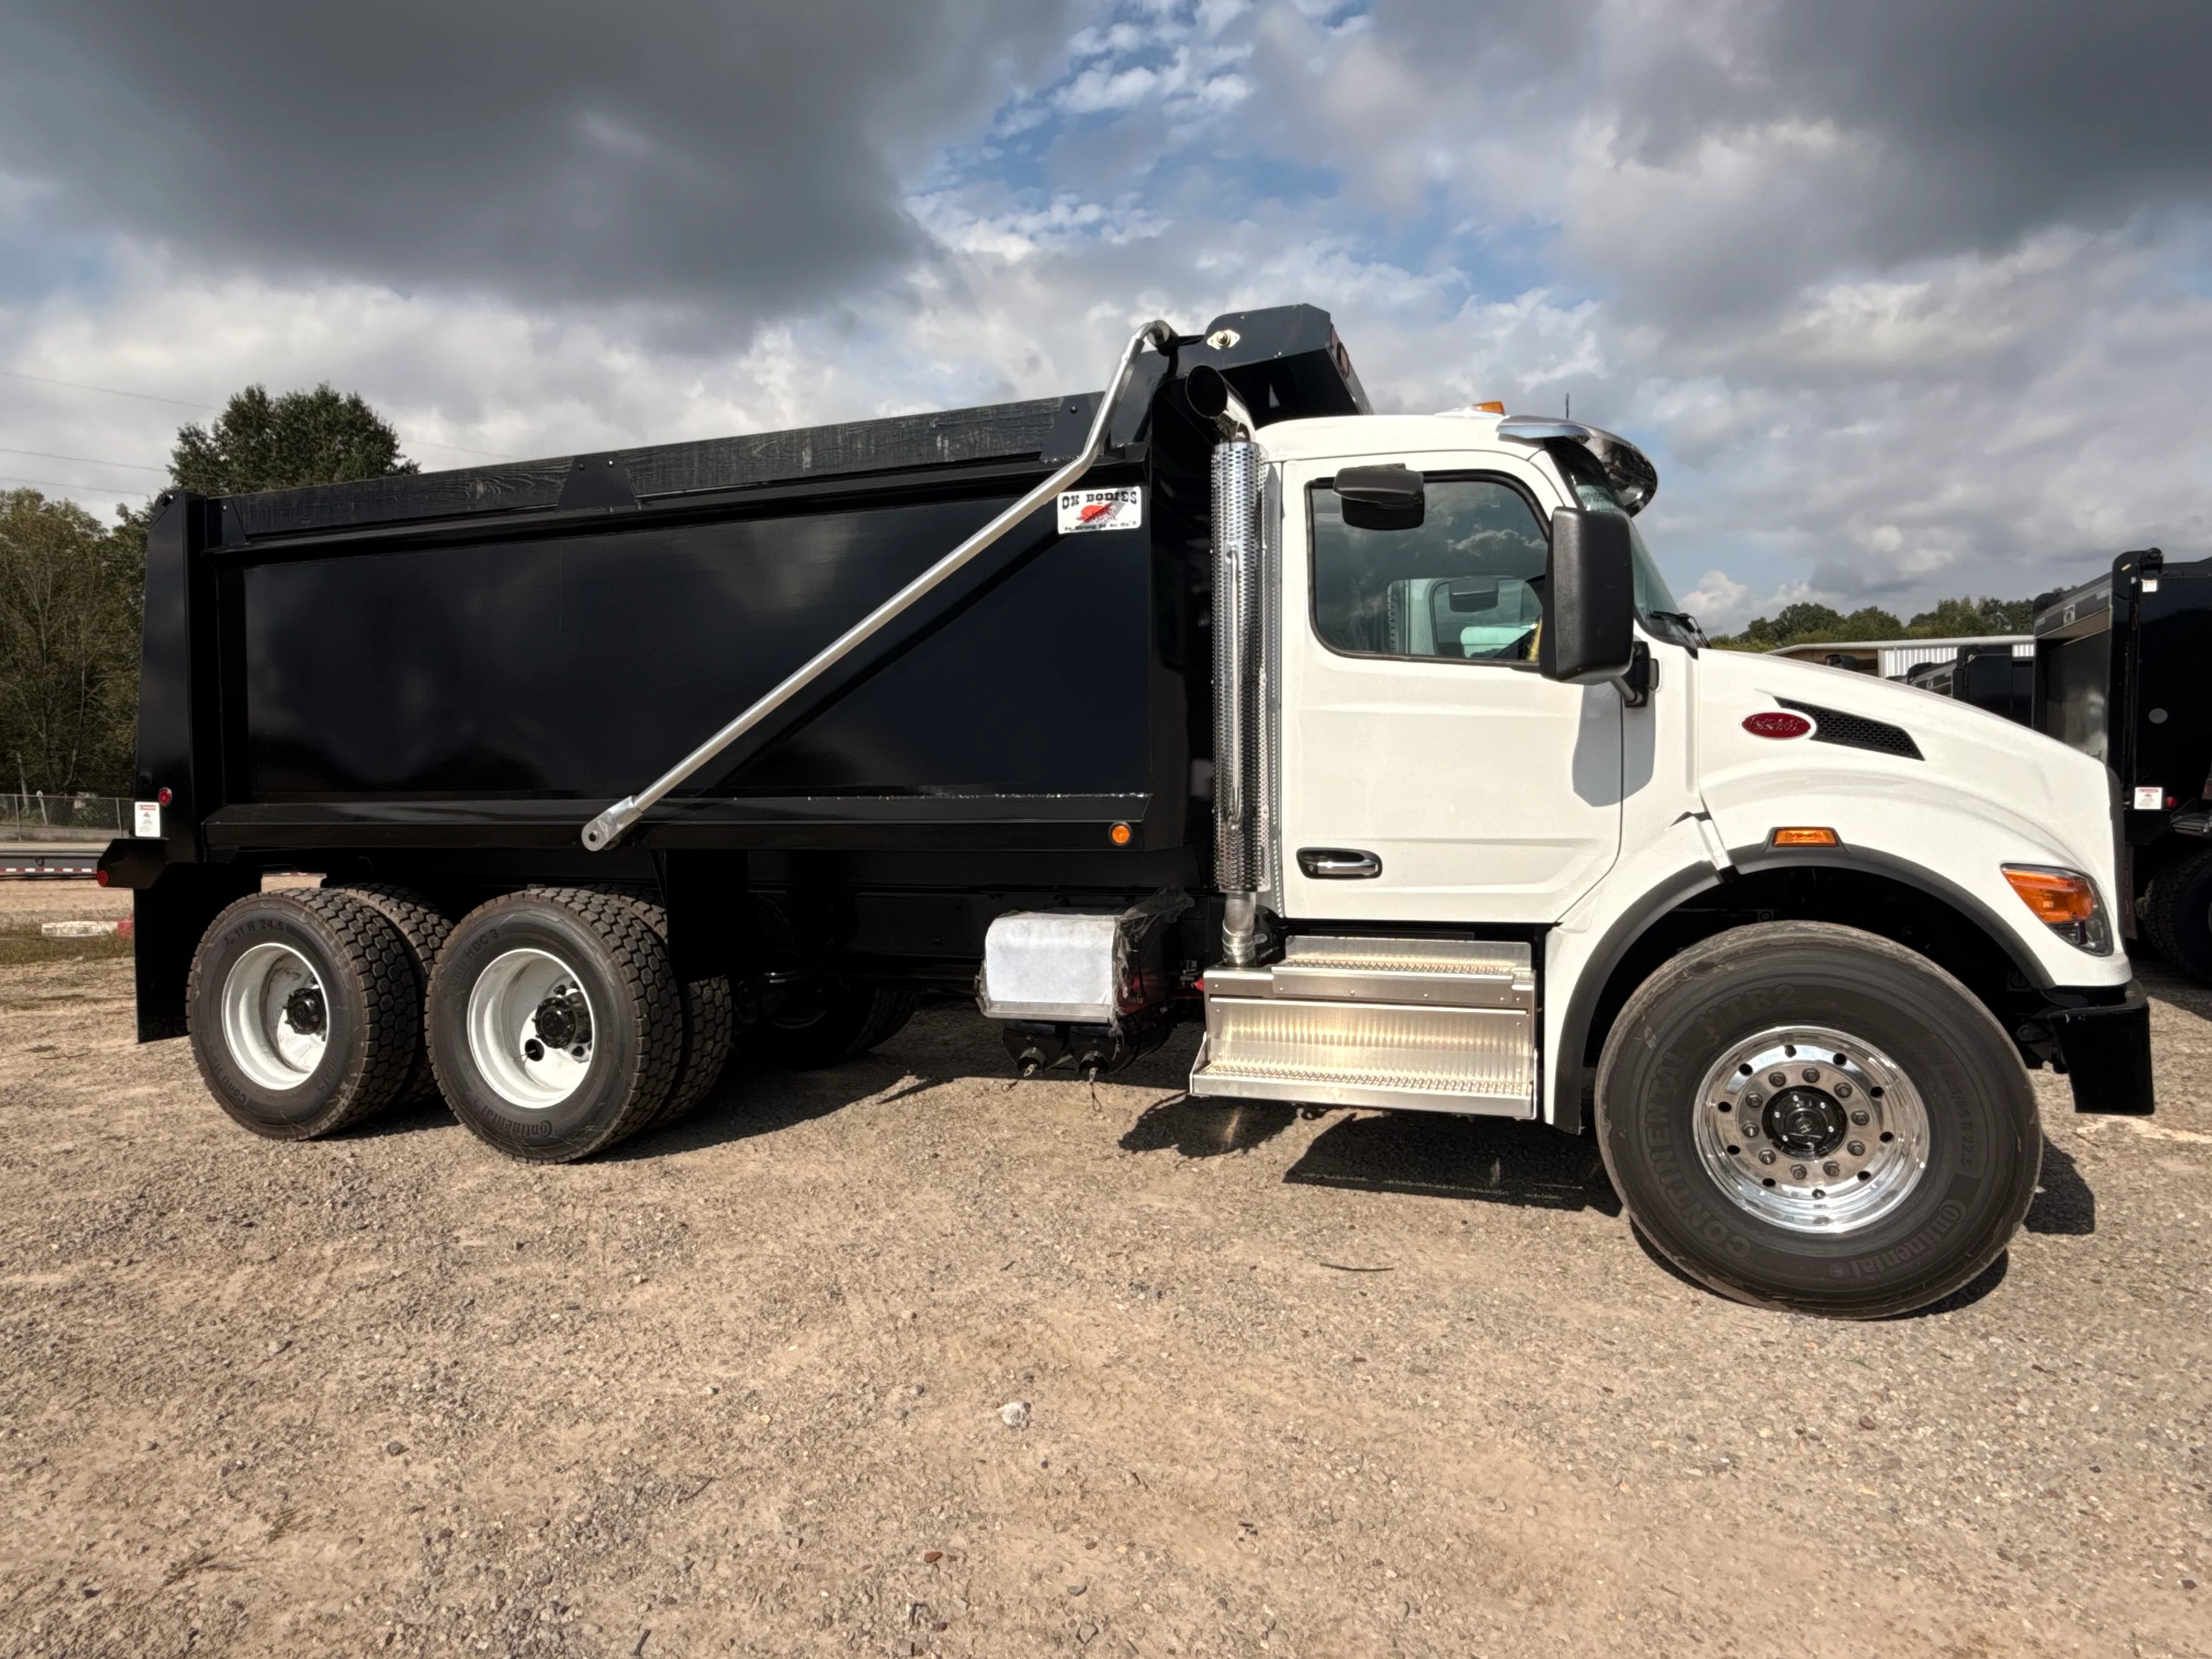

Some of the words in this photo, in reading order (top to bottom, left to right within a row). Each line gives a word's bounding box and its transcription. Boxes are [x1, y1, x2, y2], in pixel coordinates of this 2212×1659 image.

[1086, 491, 1137, 505] BODIES
[247, 921, 256, 932] R
[259, 919, 285, 932] 24.5
[464, 934, 489, 960] HDC
[490, 928, 499, 939] 3
[483, 1105, 554, 1138] Continental
[1961, 1121, 1973, 1131] R
[1646, 1051, 1751, 1259] CONTINENTAL
[1960, 1136, 1974, 1166] 22.5
[1849, 1199, 1967, 1279] Continental
